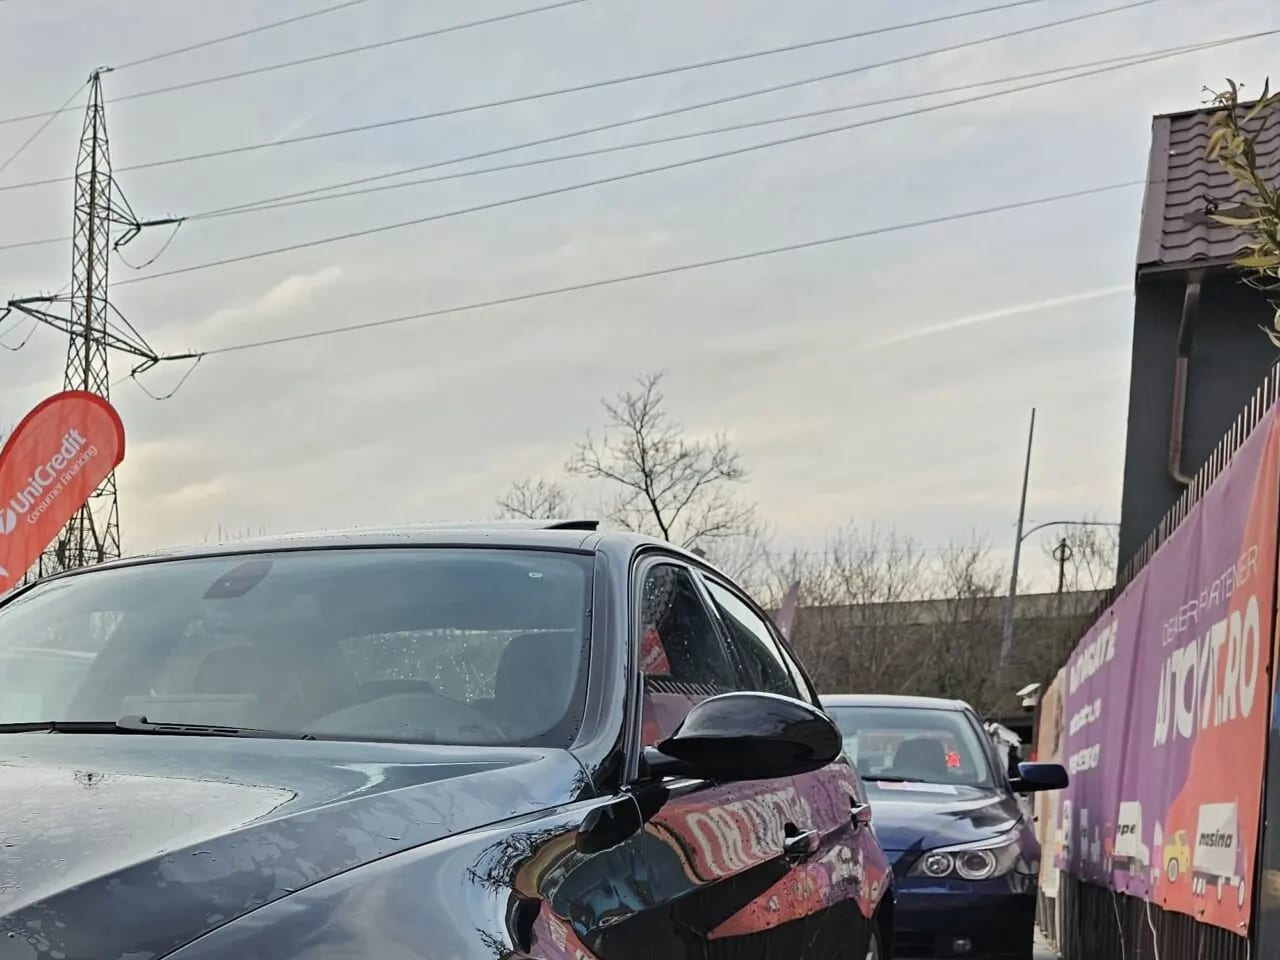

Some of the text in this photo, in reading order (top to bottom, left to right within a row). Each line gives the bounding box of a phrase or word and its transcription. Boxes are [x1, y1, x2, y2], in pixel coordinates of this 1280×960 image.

[9, 427, 87, 515] UniCredit
[27, 444, 98, 525] Consumer Financing
